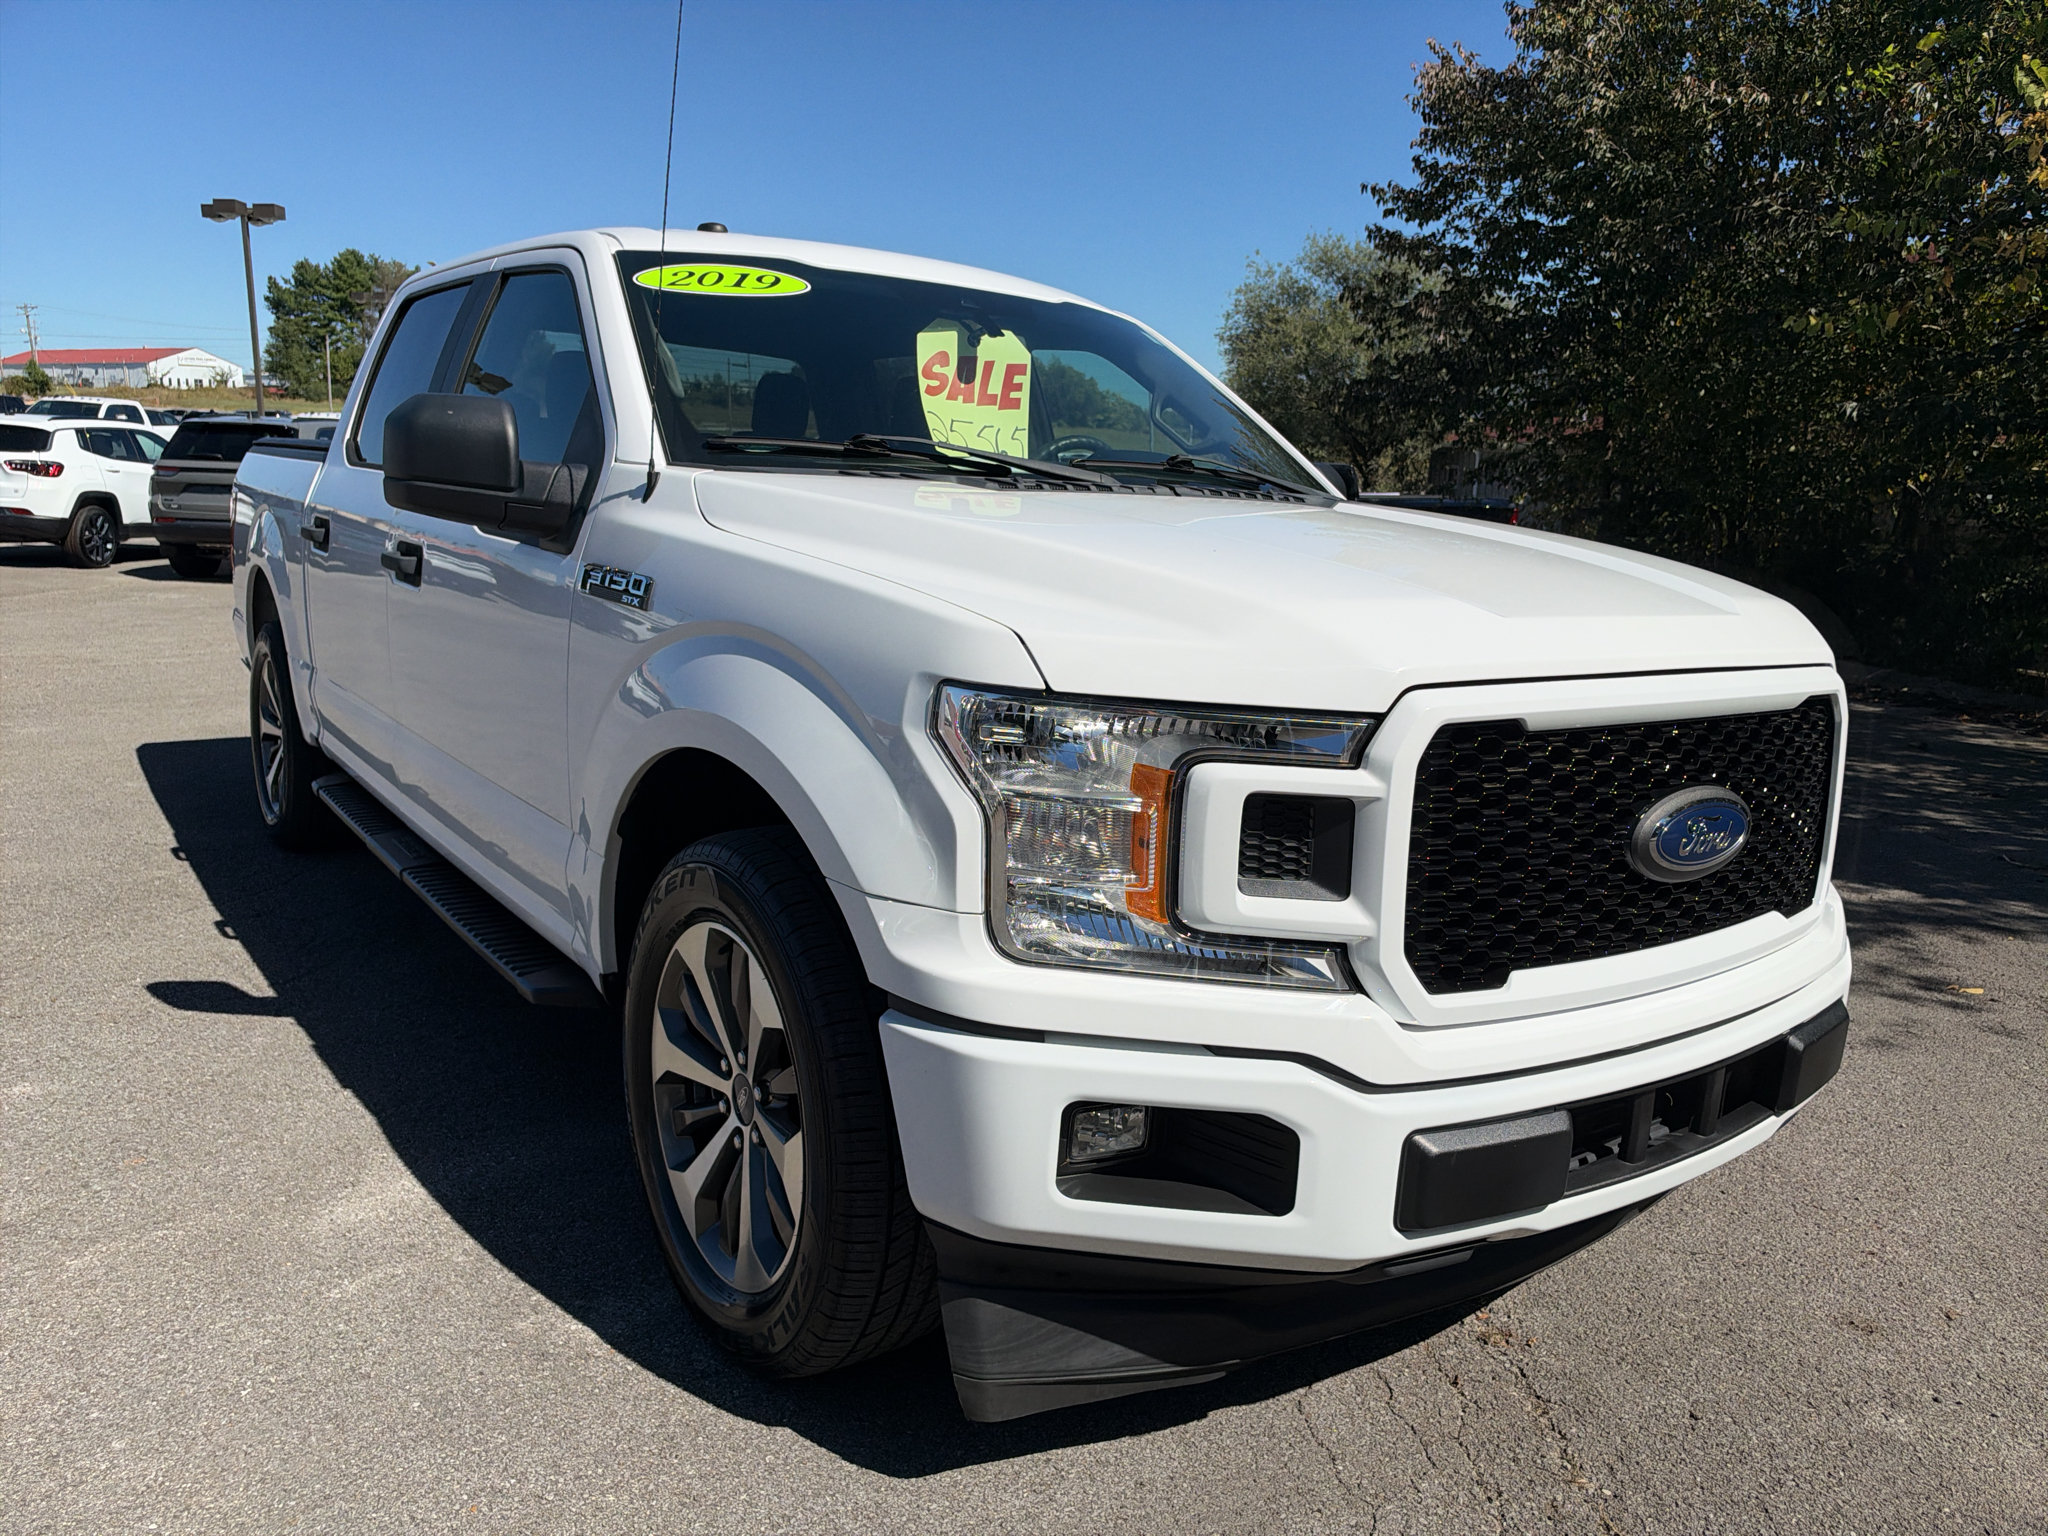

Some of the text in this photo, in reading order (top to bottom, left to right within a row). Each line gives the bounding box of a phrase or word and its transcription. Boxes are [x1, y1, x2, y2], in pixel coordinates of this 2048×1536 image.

[666, 270, 782, 290] 2019
[921, 350, 1028, 411] SALE
[621, 595, 641, 607] STX
[1678, 815, 1734, 857] Ford
